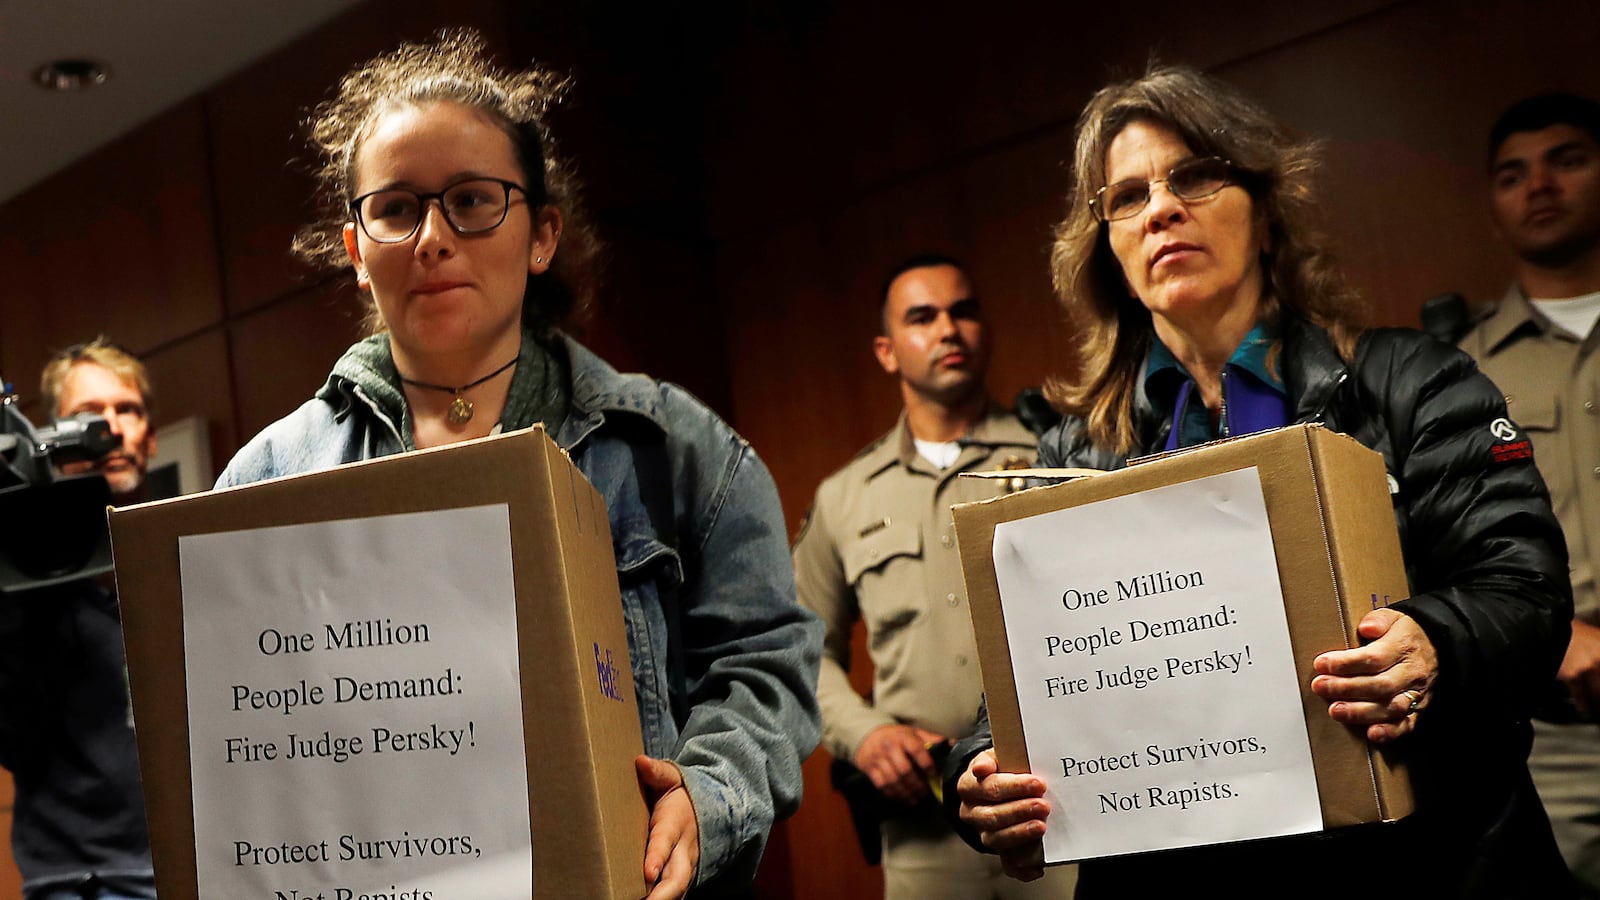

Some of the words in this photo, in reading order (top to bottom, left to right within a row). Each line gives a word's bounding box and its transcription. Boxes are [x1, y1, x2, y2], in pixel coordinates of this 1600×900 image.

[1062, 590, 1110, 612] One
[1115, 570, 1205, 602] Million
[258, 629, 315, 656] One
[324, 618, 431, 651] Million
[1045, 627, 1123, 659] People
[1128, 605, 1238, 643] Demand:
[231, 680, 325, 716] People
[333, 667, 463, 705] Demand:
[1045, 675, 1090, 700] Fire
[1095, 664, 1160, 690] Judge
[1164, 644, 1253, 680] Persky!
[224, 736, 278, 764] Fire
[285, 729, 364, 763] Judge
[371, 720, 476, 756] Persky!
[1060, 749, 1142, 778] Protect
[1145, 736, 1268, 768] Survivors,
[1097, 791, 1144, 815] Not
[1145, 780, 1240, 812] Rapists.
[233, 839, 330, 867] Protect
[338, 831, 482, 863] Survivors,
